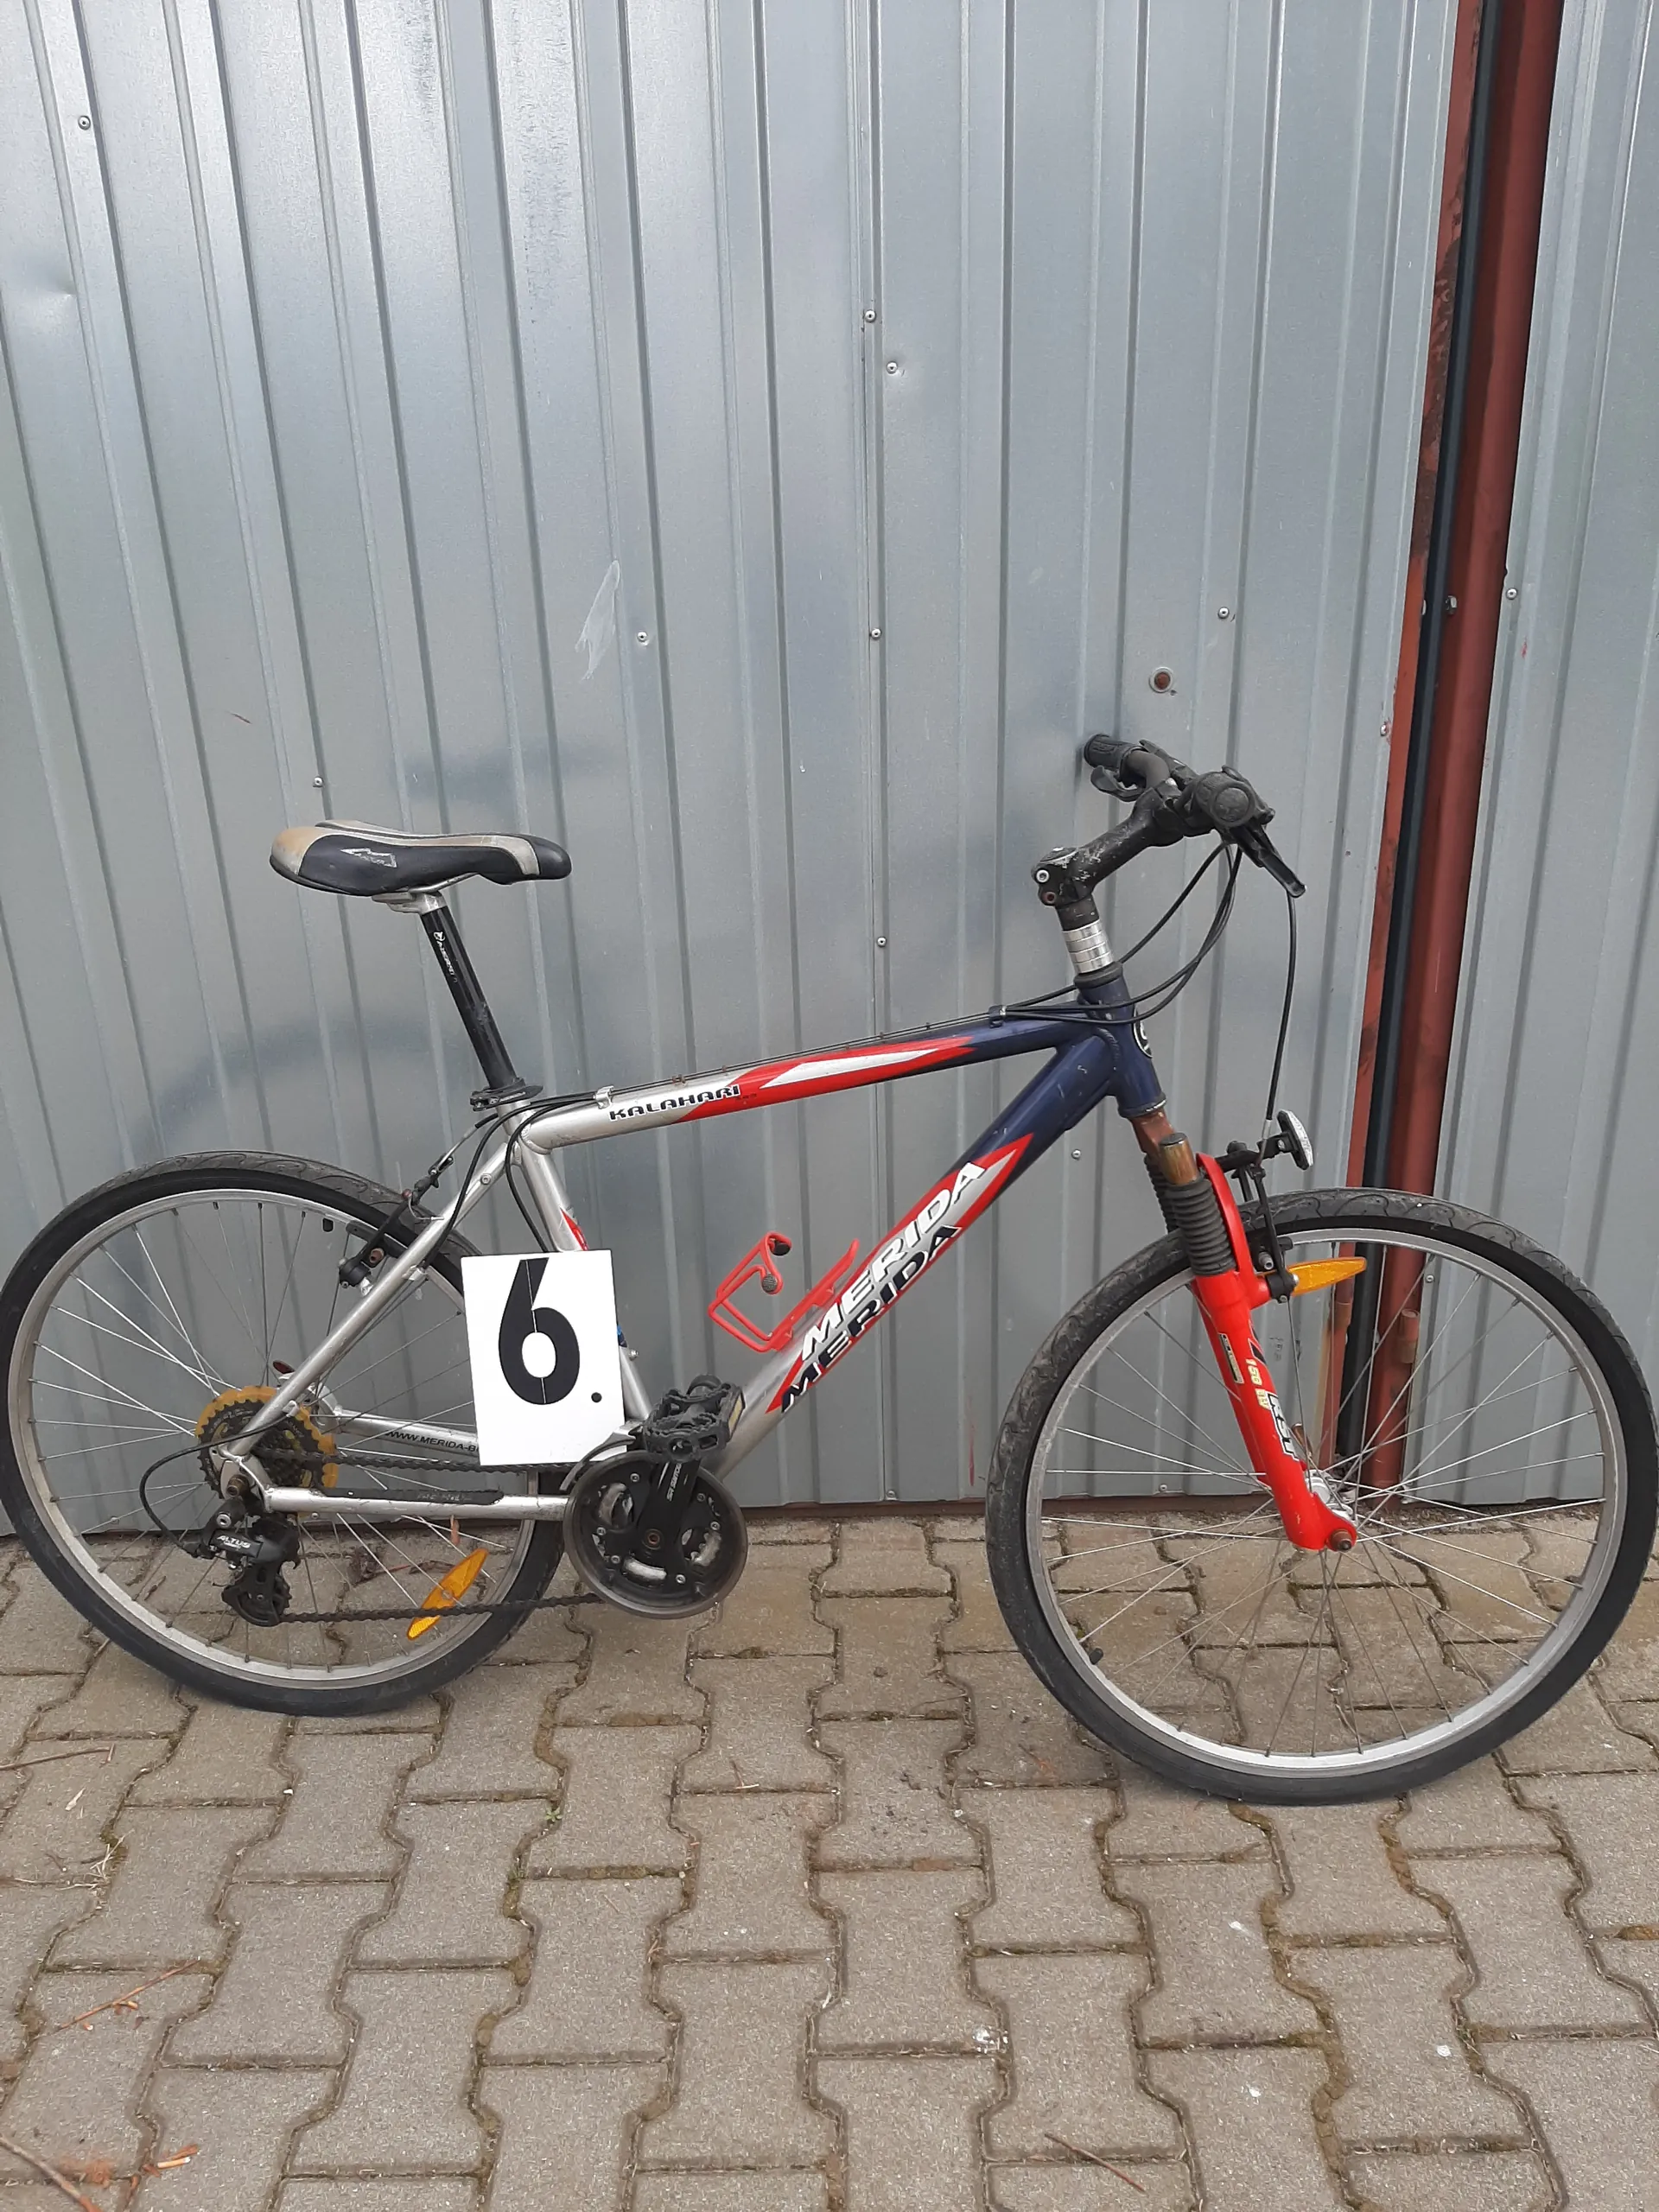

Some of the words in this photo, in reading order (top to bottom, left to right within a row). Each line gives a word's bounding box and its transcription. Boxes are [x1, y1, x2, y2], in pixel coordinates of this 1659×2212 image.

[609, 1084, 741, 1122] KALAHARI
[802, 1160, 987, 1361] MERIDA
[781, 1224, 962, 1413] MERIDA
[217, 1535, 251, 1548] ALTUS
